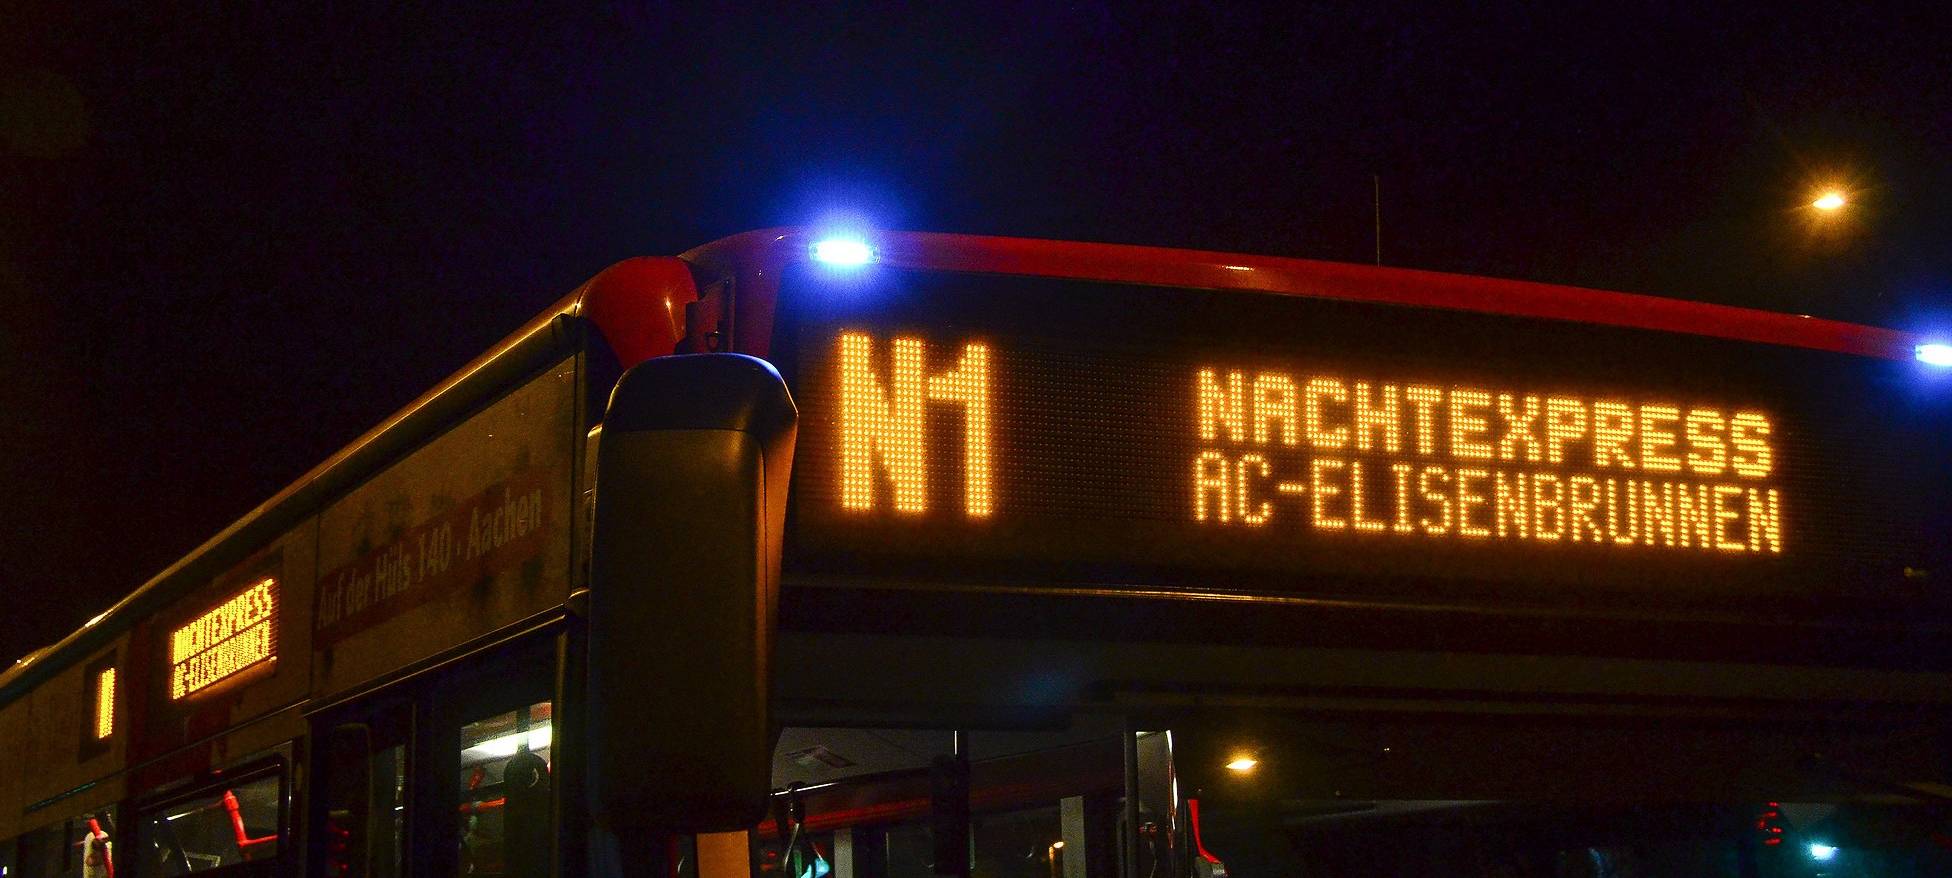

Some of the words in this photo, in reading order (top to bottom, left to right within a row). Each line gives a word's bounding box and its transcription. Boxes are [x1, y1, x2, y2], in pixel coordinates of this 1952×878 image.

[838, 332, 993, 518] N1
[1197, 368, 1774, 479] NACHTEXPRESS
[346, 567, 371, 616] der
[375, 543, 411, 602] Hüls
[418, 520, 452, 583] 140
[466, 486, 542, 561] Aachen
[1194, 450, 1784, 555] AC-ELISENBRUNNEN
